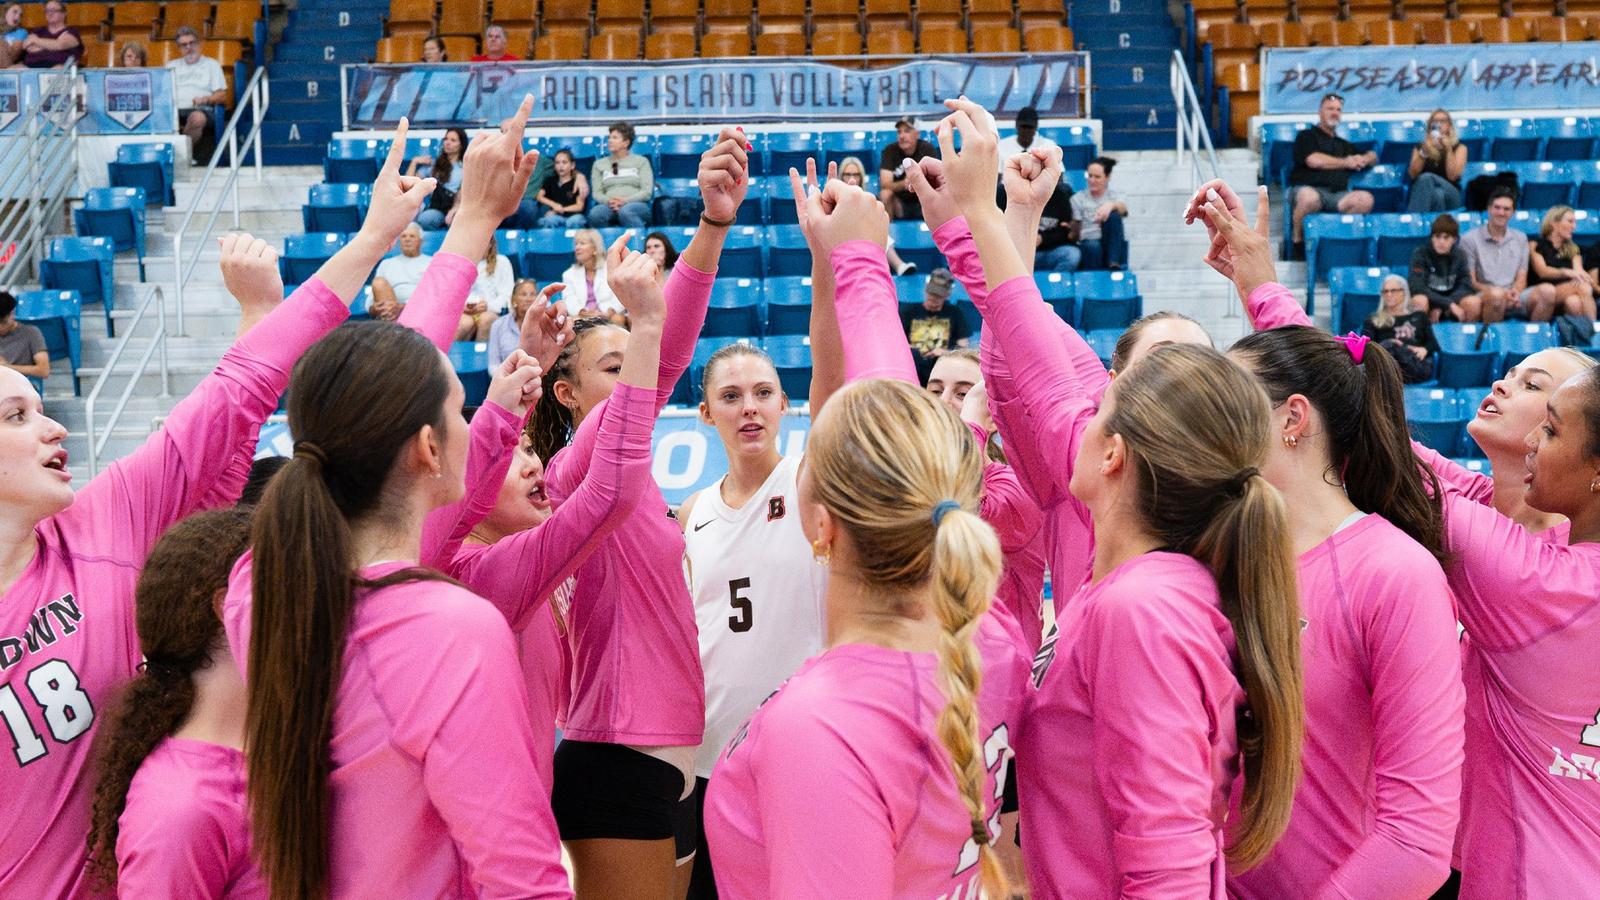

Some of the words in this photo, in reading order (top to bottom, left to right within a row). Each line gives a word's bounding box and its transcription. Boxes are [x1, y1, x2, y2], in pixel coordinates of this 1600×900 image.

[1109, 0, 1120, 13] D
[339, 11, 350, 27] D
[1119, 32, 1131, 48] C
[324, 46, 335, 60] C
[1132, 66, 1144, 83] B
[1277, 63, 1468, 94] POSTSEASON
[1474, 59, 1600, 92] APPEAR
[307, 80, 318, 98] B
[543, 75, 639, 111] RHODE
[653, 73, 756, 109] ISLAND
[770, 70, 945, 107] VOLLEYBALL
[1147, 108, 1158, 125] A
[289, 123, 300, 140] A
[768, 496, 785, 522] B
[728, 576, 753, 633] 5
[0, 657, 96, 768] 18
